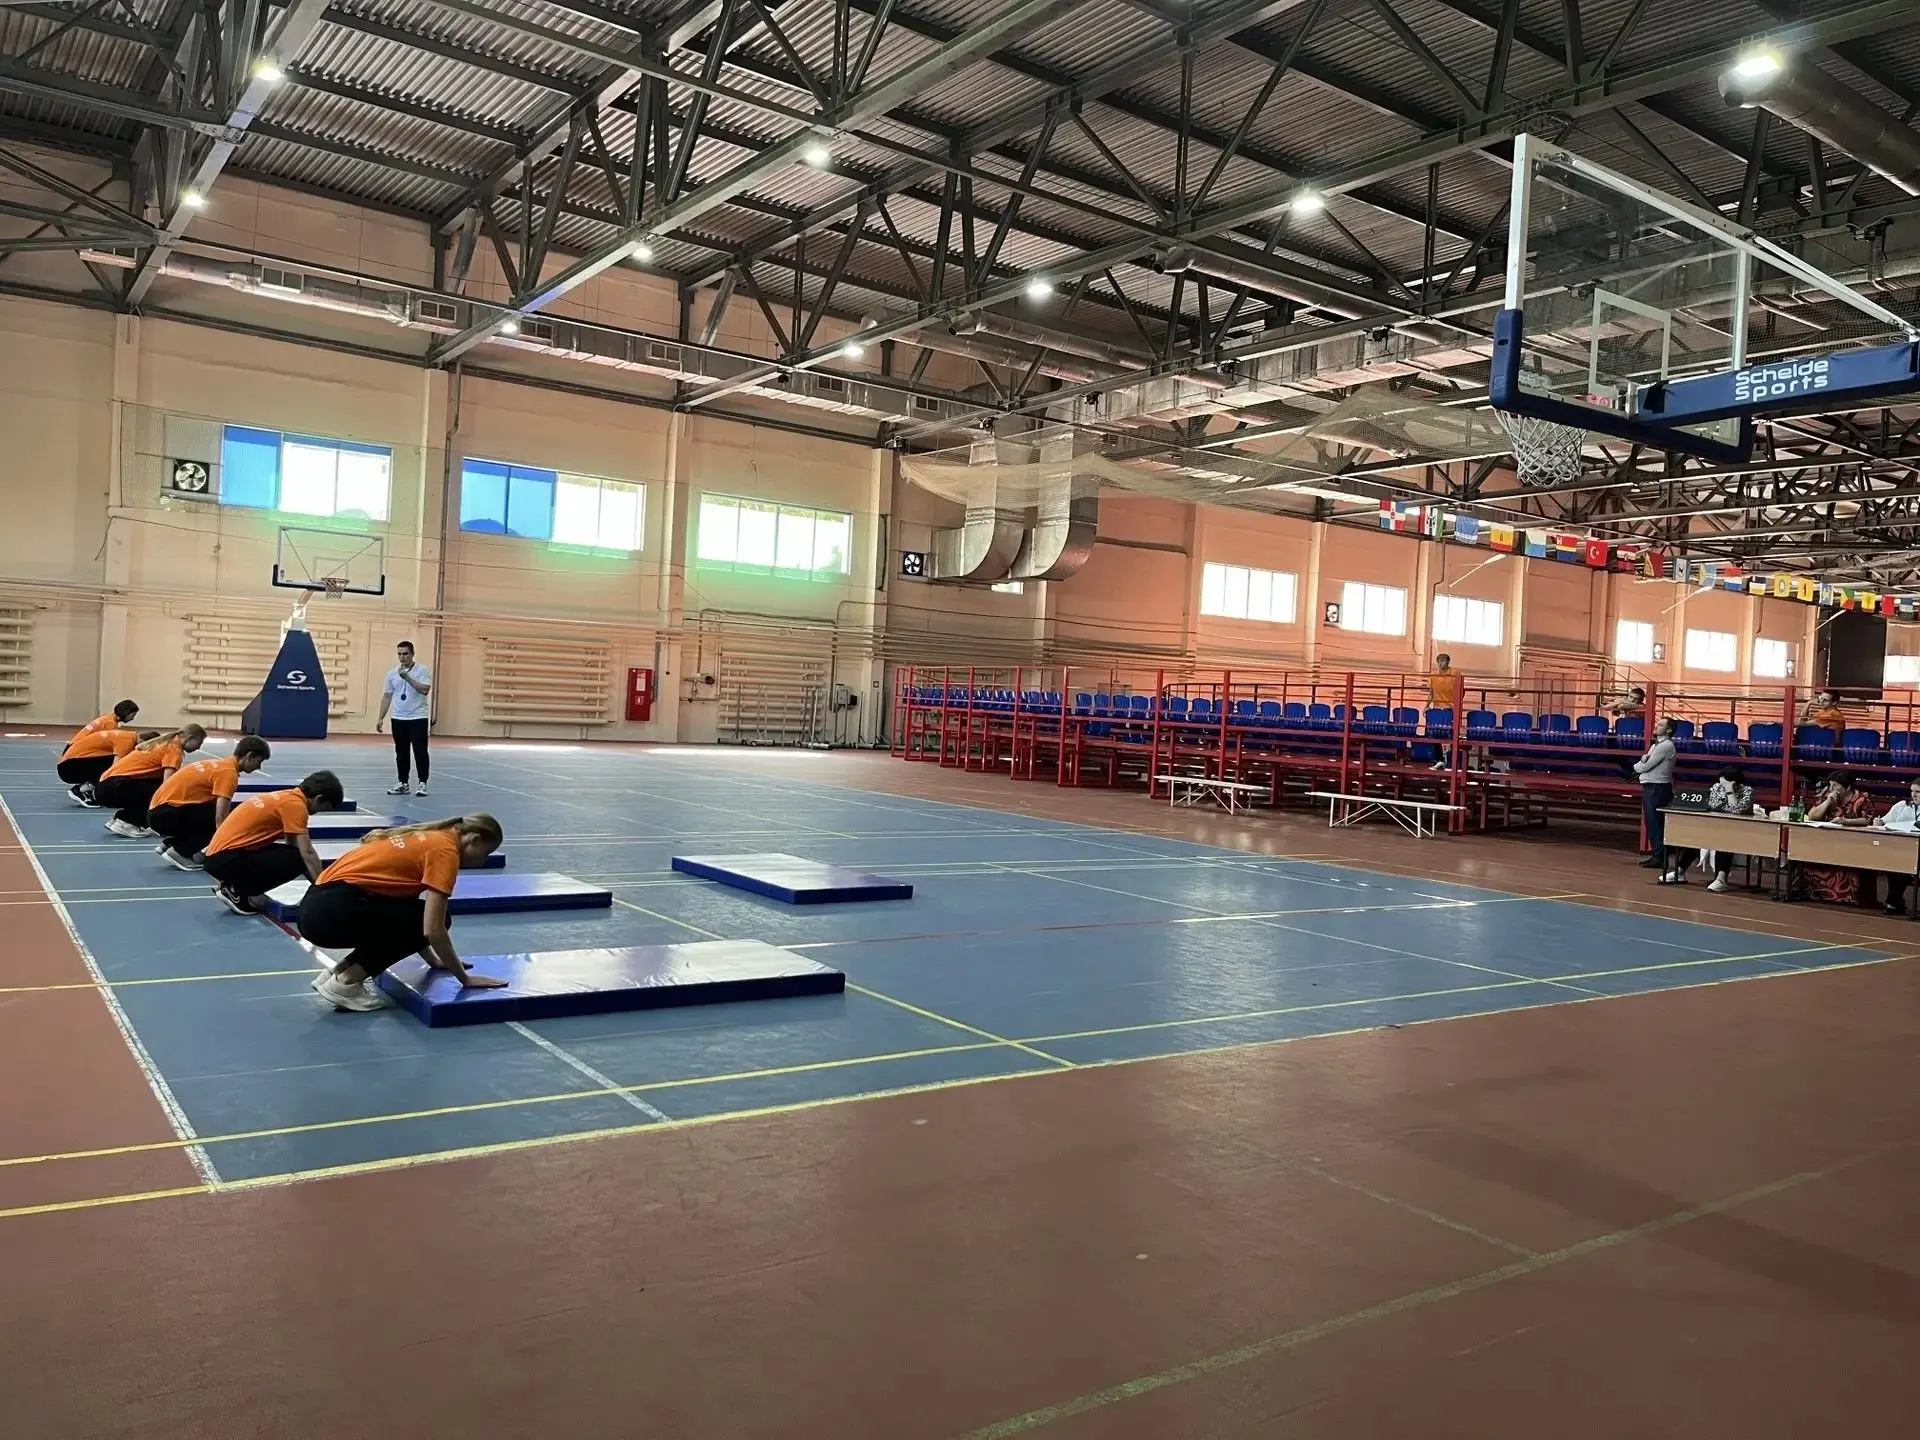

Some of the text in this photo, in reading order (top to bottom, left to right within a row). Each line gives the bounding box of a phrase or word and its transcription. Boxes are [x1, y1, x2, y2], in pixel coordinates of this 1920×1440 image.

[1735, 360, 1829, 387] Schelde
[1735, 375, 1829, 402] Sports
[1680, 792, 1703, 803] 9:20
